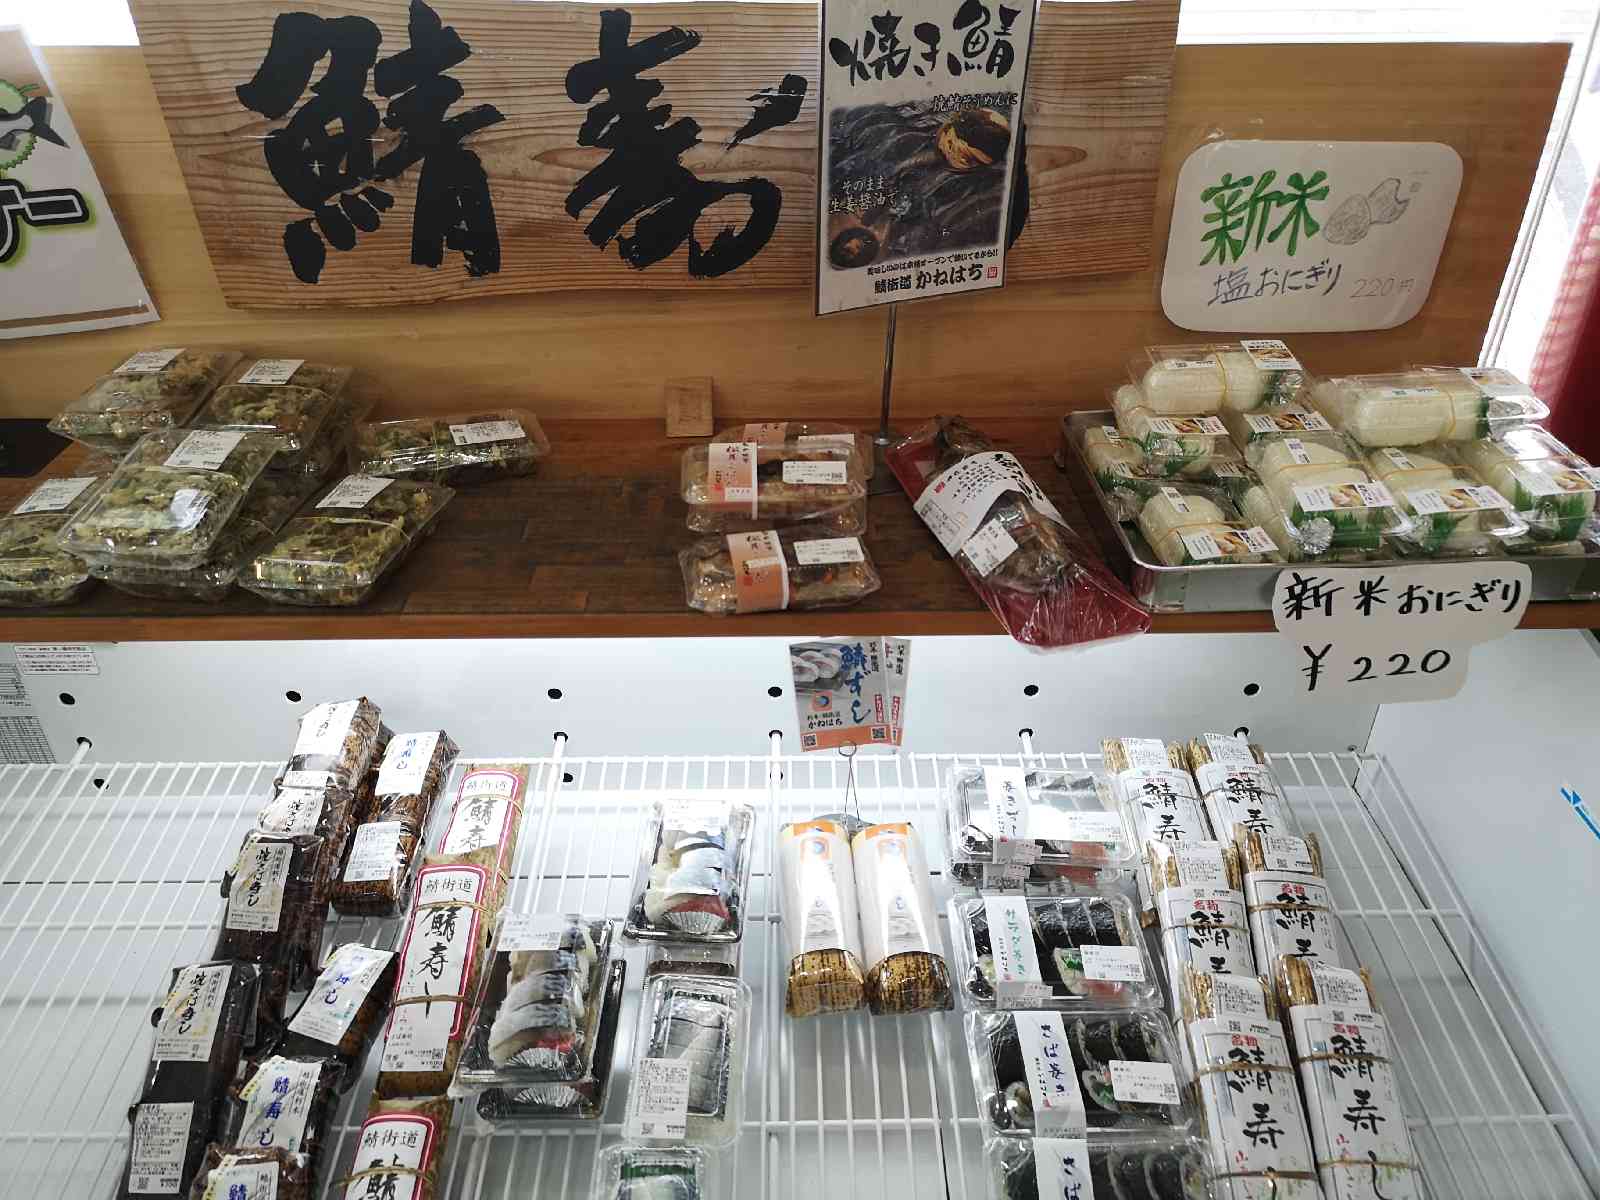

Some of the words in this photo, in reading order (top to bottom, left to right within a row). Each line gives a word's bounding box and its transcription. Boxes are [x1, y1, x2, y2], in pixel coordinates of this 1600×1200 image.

[829, 0, 1022, 86] 焼き鯖
[1200, 170, 1331, 266] 新米
[915, 263, 984, 290] かねはち
[1207, 258, 1342, 306] 塩おにぎり
[1282, 572, 1521, 621] 新米おにぎり
[415, 906, 463, 1020] 鯖寿し
[259, 1076, 290, 1147] 鯖寿し
[363, 1128, 419, 1149] 鯖街道
